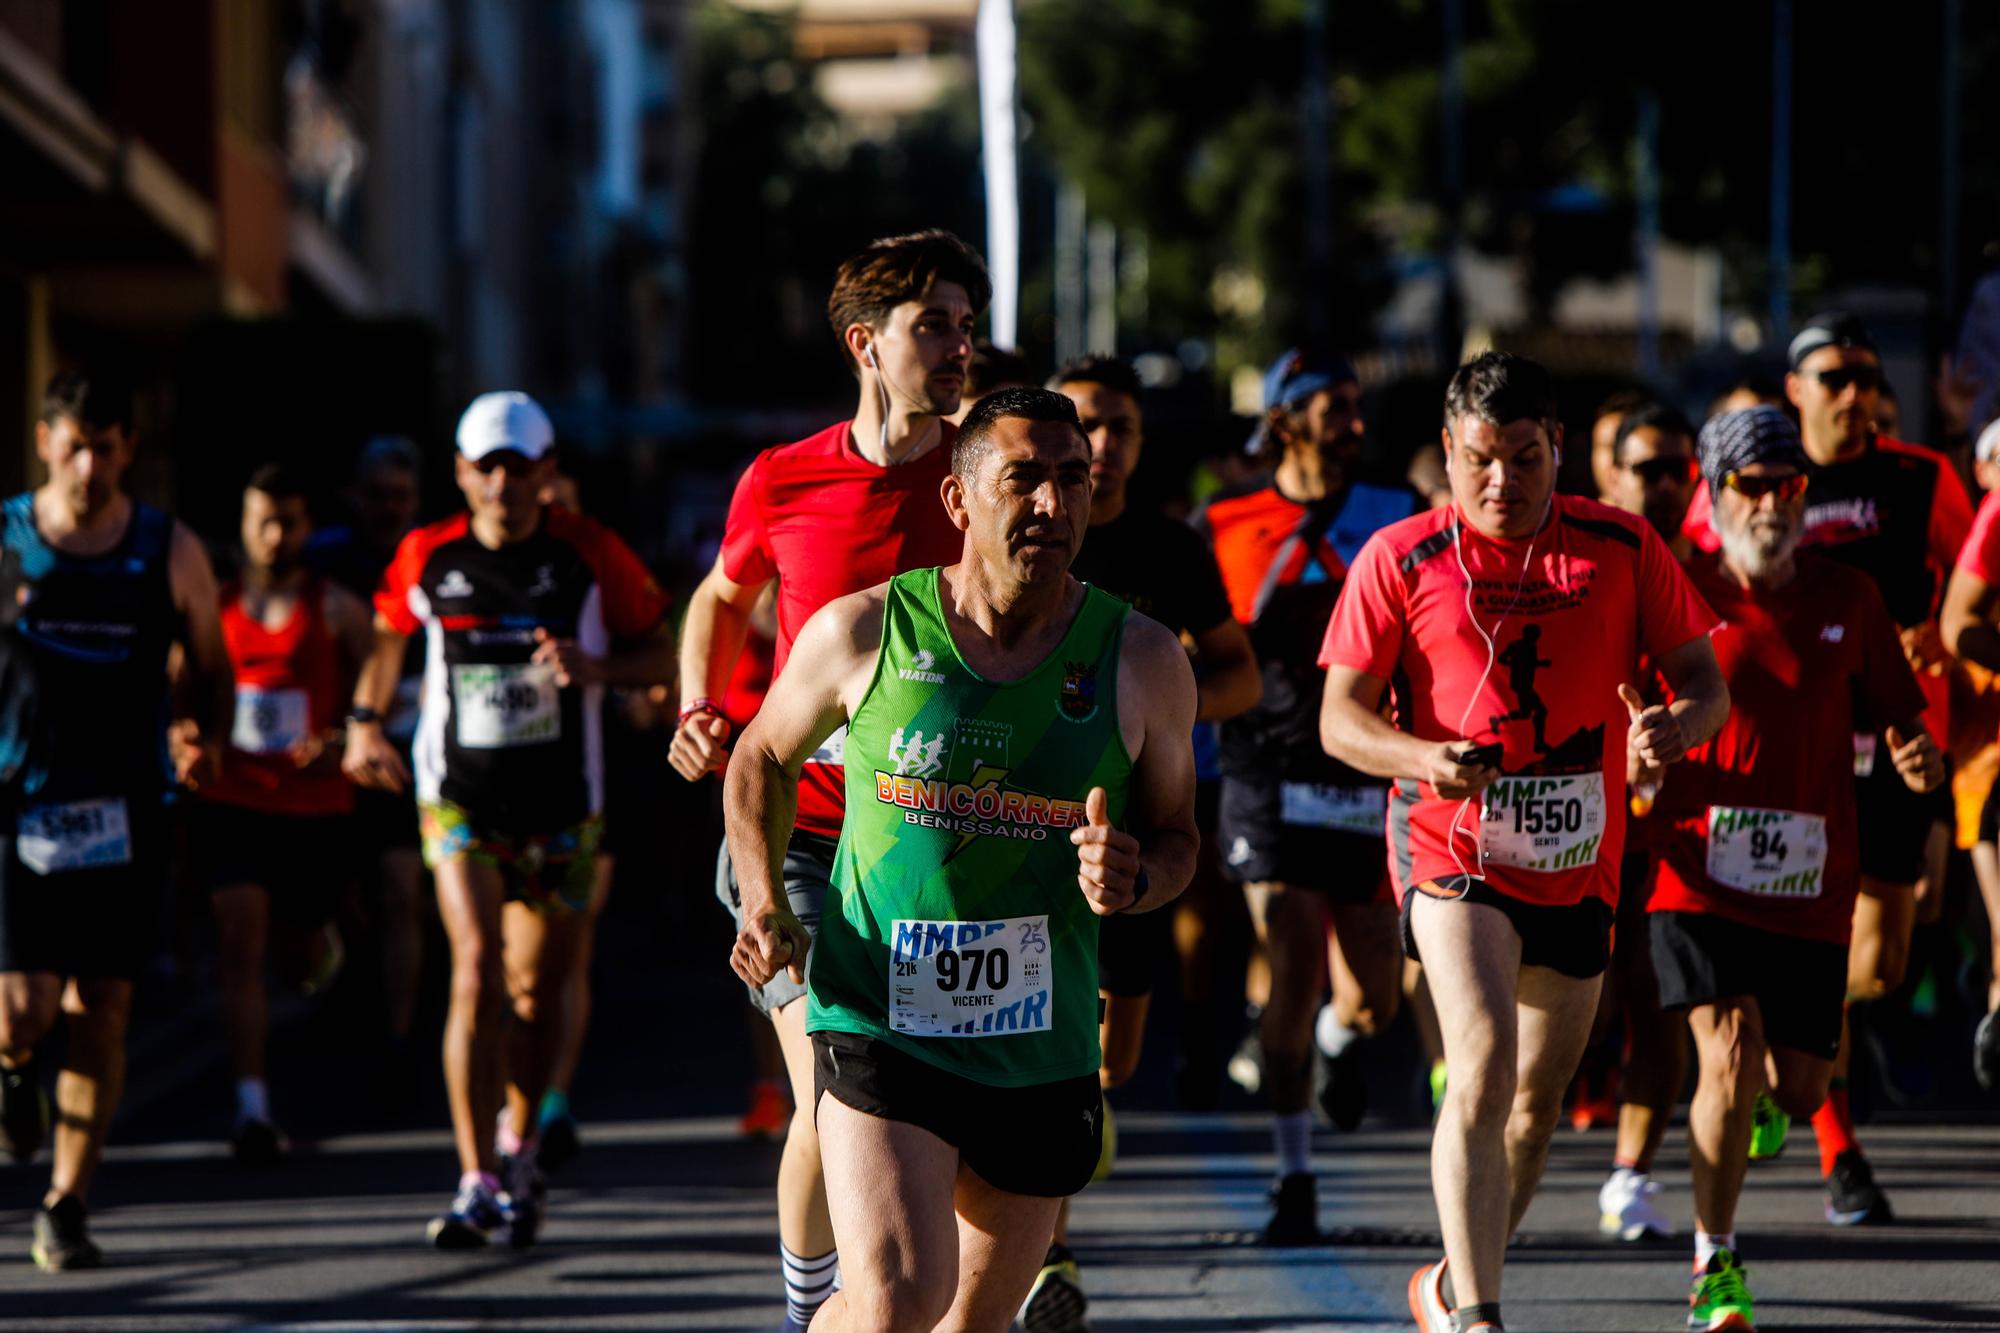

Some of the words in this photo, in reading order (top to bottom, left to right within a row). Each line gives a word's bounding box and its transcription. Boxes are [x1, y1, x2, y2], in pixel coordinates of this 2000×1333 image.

[898, 668, 945, 684] VIATOR
[904, 811, 1047, 841] BENISSANÓ
[1514, 797, 1582, 834] 1550
[1750, 828, 1788, 861] 94
[936, 948, 1009, 992] 970
[952, 994, 995, 1007] VICENTE
